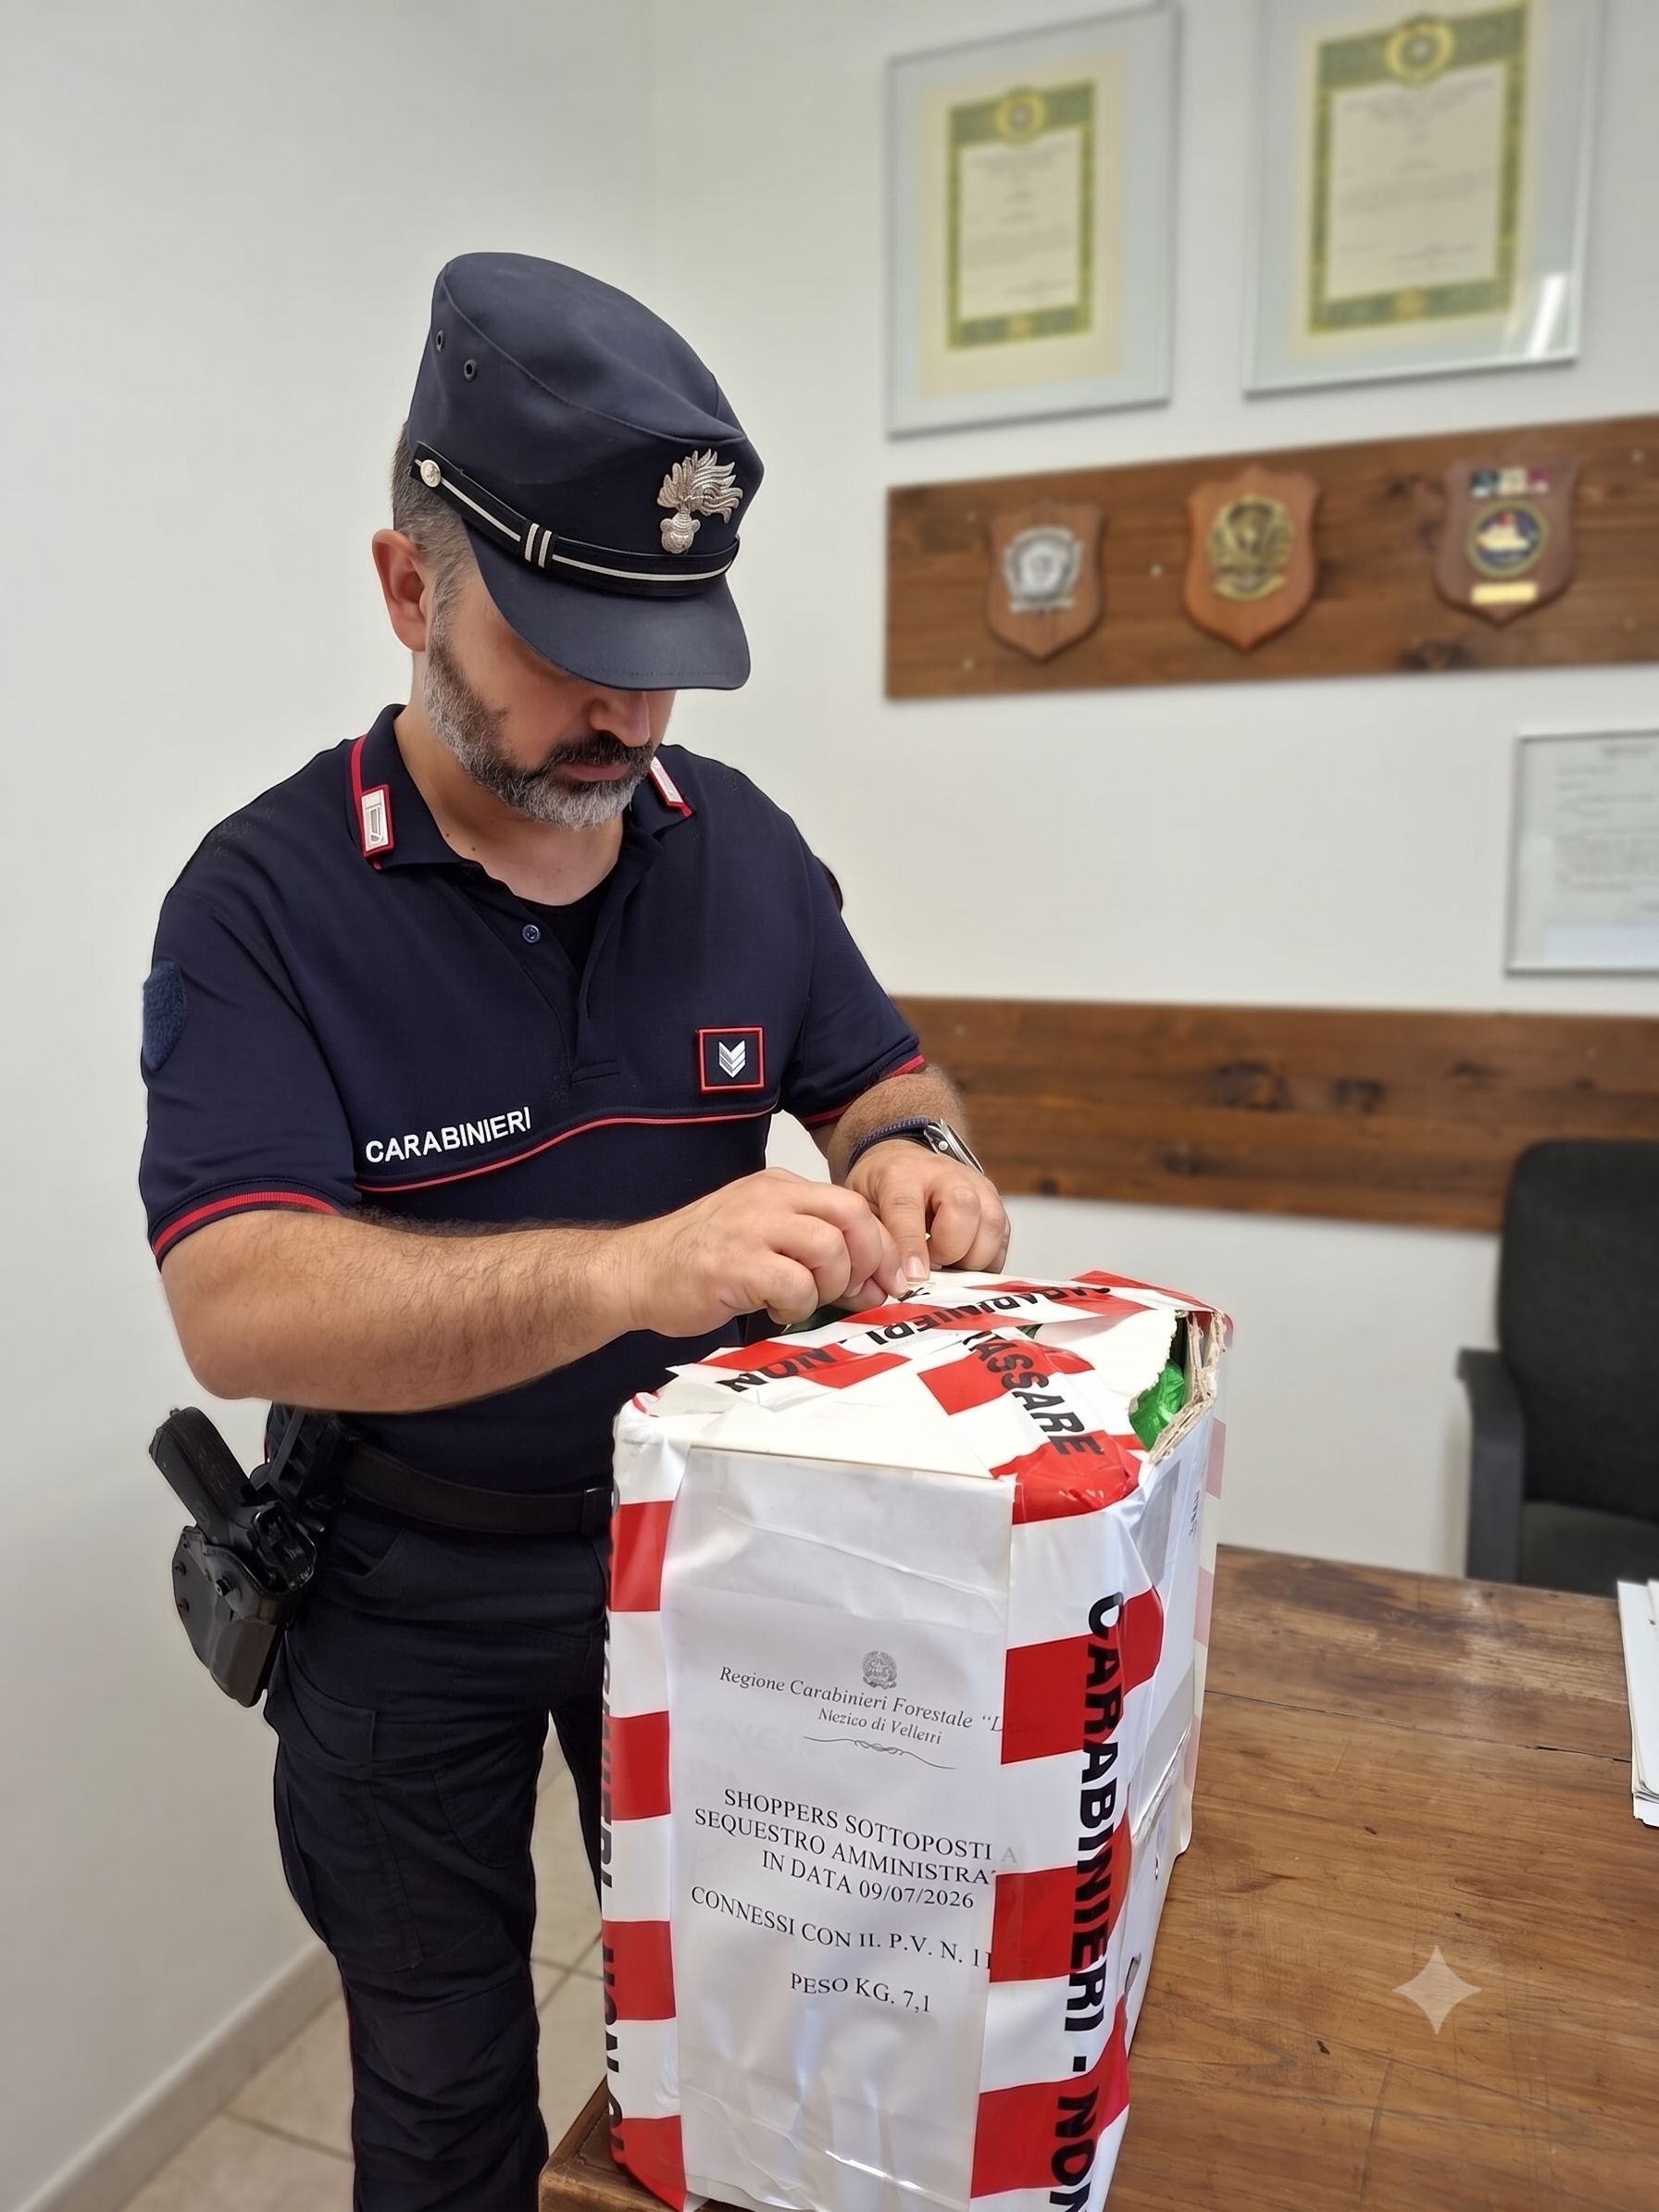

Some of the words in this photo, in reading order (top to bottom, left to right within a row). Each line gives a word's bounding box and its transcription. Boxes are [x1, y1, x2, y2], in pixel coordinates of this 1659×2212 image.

[365, 1106, 531, 1163] CARABINIERI
[716, 1347, 841, 1392] NON
[719, 1666, 786, 1692] Regione
[790, 1679, 888, 1711] Carabinieri
[892, 1696, 973, 1730] Forestale
[871, 1717, 886, 1732] di
[724, 1788, 838, 1829] SHOPPERS
[845, 1814, 992, 1861] SOTTOPOSTI
[1065, 1590, 1123, 2032] CARABINIERI
[694, 1808, 826, 1855] SEQUESTRO
[831, 1841, 996, 1885] AMMINISTRA
[762, 1850, 784, 1873] IN
[790, 1858, 852, 1895] DATA
[858, 1879, 974, 1909] 09/07/2026
[692, 1885, 795, 1935] CONNESSI
[801, 1922, 851, 1948] CON
[889, 1932, 932, 1956] P.V.
[940, 1940, 963, 1963] N.
[791, 1972, 849, 1995] PESO
[854, 1977, 895, 2004] KG.
[903, 1991, 930, 2013] 7,1
